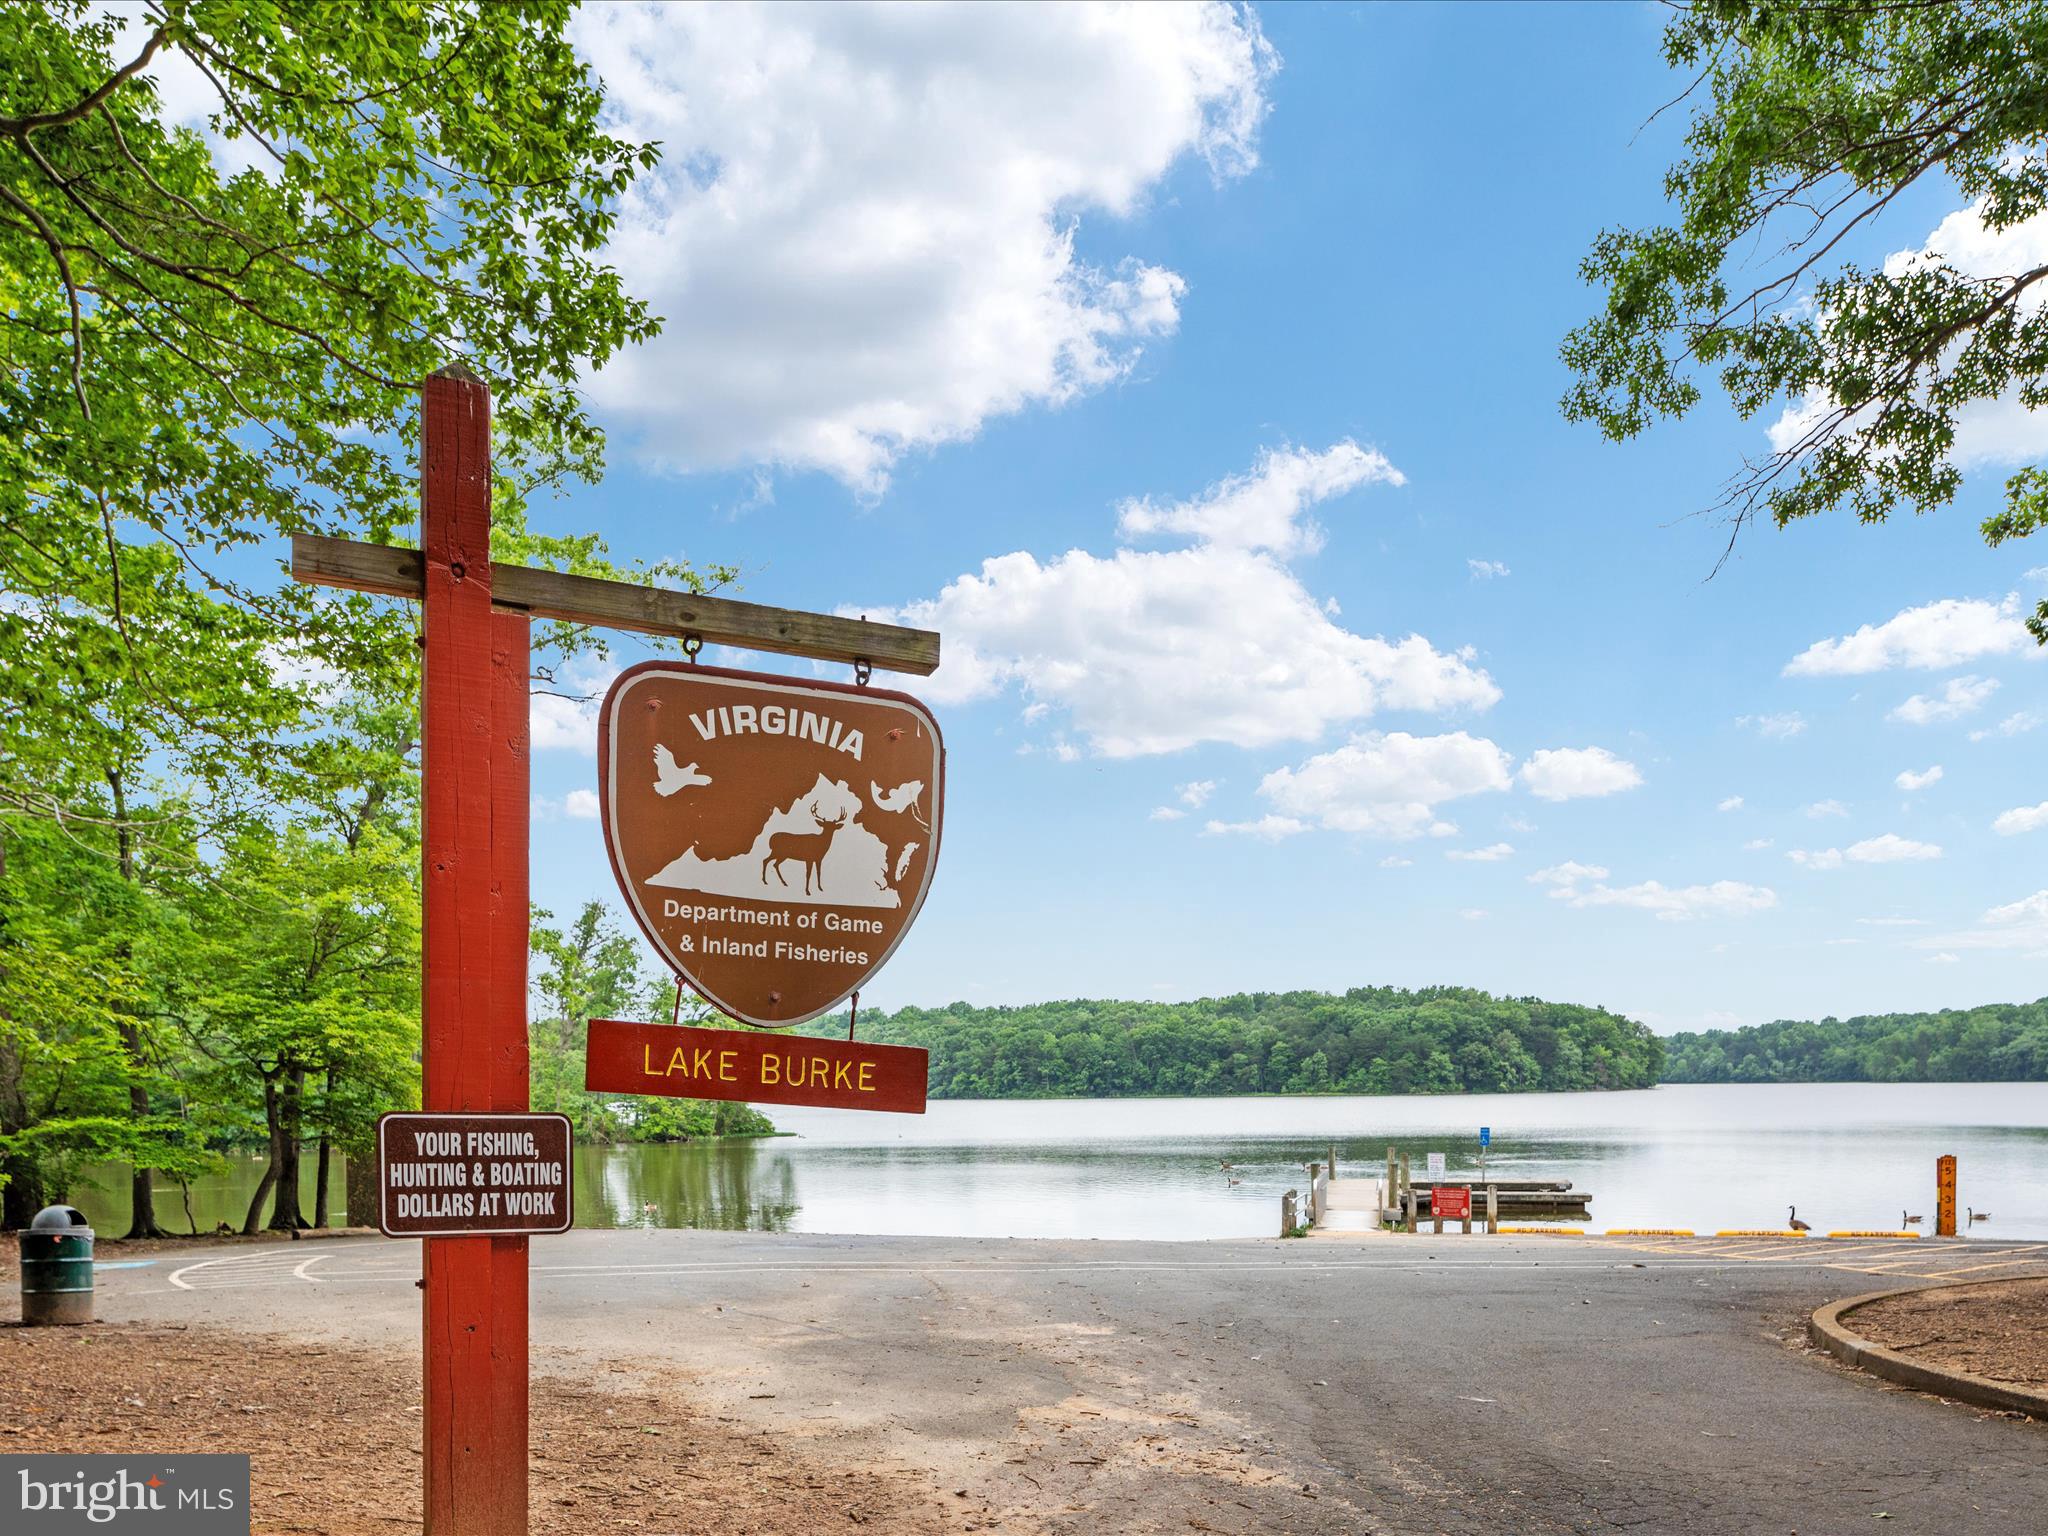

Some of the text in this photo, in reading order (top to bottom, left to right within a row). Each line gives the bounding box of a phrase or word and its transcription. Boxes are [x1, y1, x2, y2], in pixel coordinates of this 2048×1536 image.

[688, 705, 864, 762] VIRGINIA
[664, 899, 884, 934] Department of Game
[679, 934, 869, 966] & Inland Fisheries
[644, 1043, 877, 1091] LAKE BURKE
[414, 1132, 540, 1160] YOUR FISHING,
[390, 1162, 562, 1187] HUNTING & BOATING
[1945, 1167, 1952, 1175] 5
[397, 1192, 556, 1218] DOLLARS AT WORK
[1945, 1210, 1952, 1218] 2
